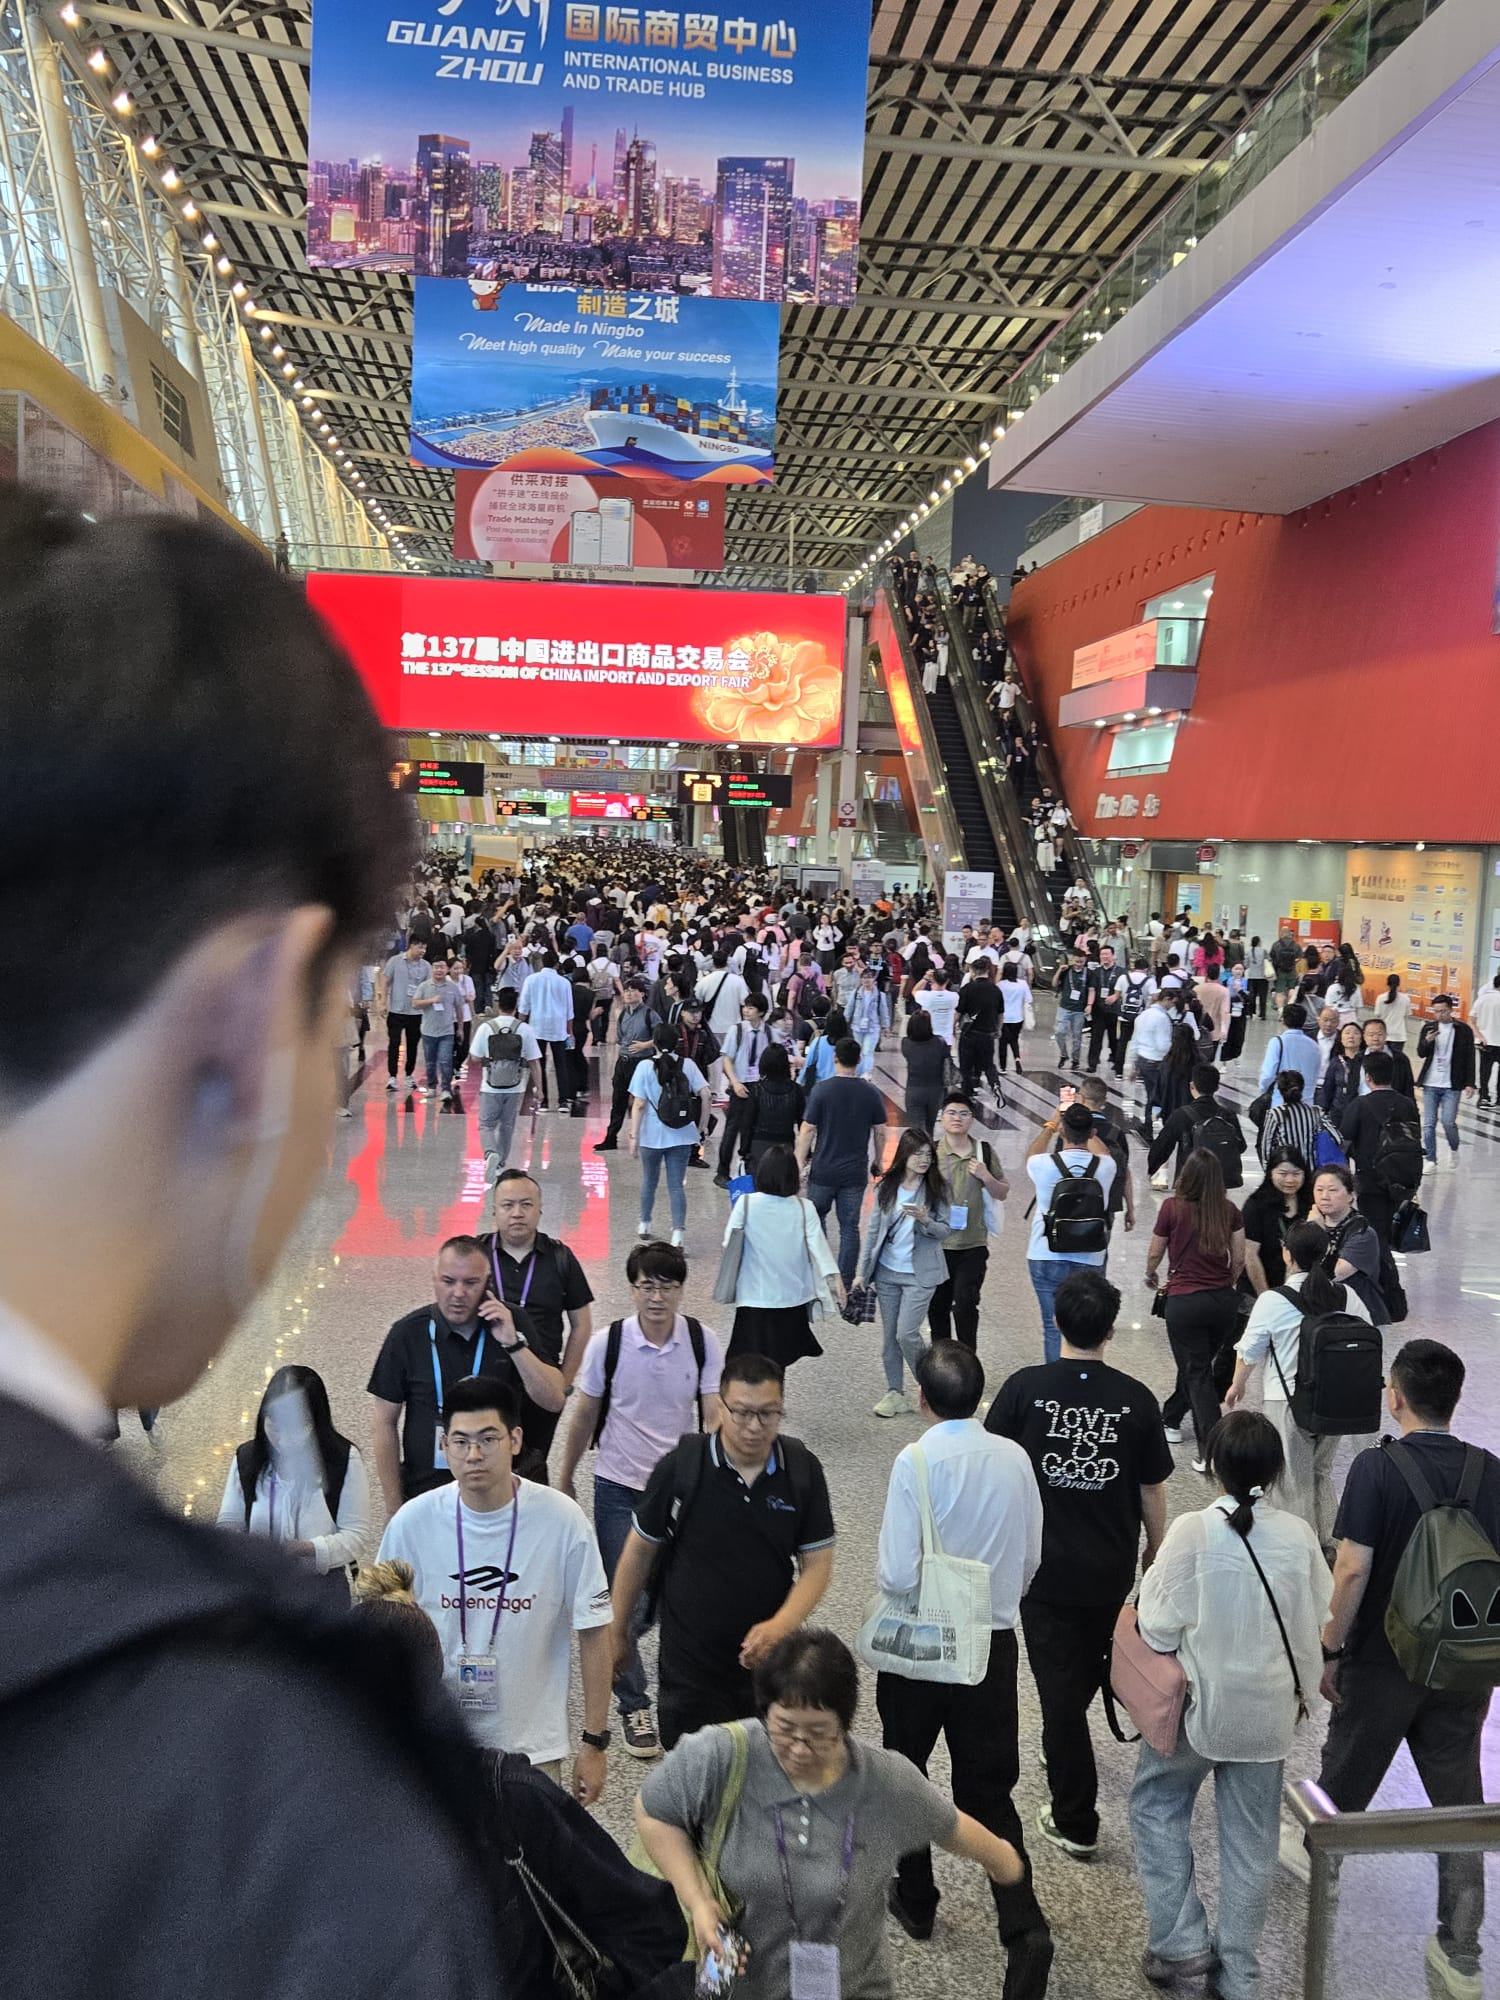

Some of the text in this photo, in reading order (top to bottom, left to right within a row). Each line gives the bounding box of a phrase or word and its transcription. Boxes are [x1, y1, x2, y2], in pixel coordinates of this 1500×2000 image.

[386, 20, 527, 54] GUANG
[565, 2, 798, 60] 国际商贸中心
[435, 54, 544, 86] ZHOU
[563, 50, 794, 85] INTERNATIONAL BUSINESS
[563, 73, 706, 99] AND TRADE HUB
[577, 294, 680, 324] 制造之城
[514, 312, 645, 340] Made In Ningbo
[459, 332, 732, 364] Meet high quality Make your success
[698, 440, 740, 454] NINGBO
[511, 473, 569, 488] 供采对接
[487, 514, 554, 526] Trade Matching
[401, 661, 430, 676] THE
[519, 666, 540, 680] OF
[540, 667, 584, 682] CHINA
[584, 669, 636, 685] IMPORT
[636, 671, 665, 686] AND
[666, 673, 718, 688] EXPORT
[721, 675, 750, 689] FAIR
[1072, 1428, 1099, 1461] IS
[1041, 1452, 1120, 1482] GOOD
[1048, 1471, 1107, 1491] Brand
[441, 1593, 532, 1614] baenciaga
